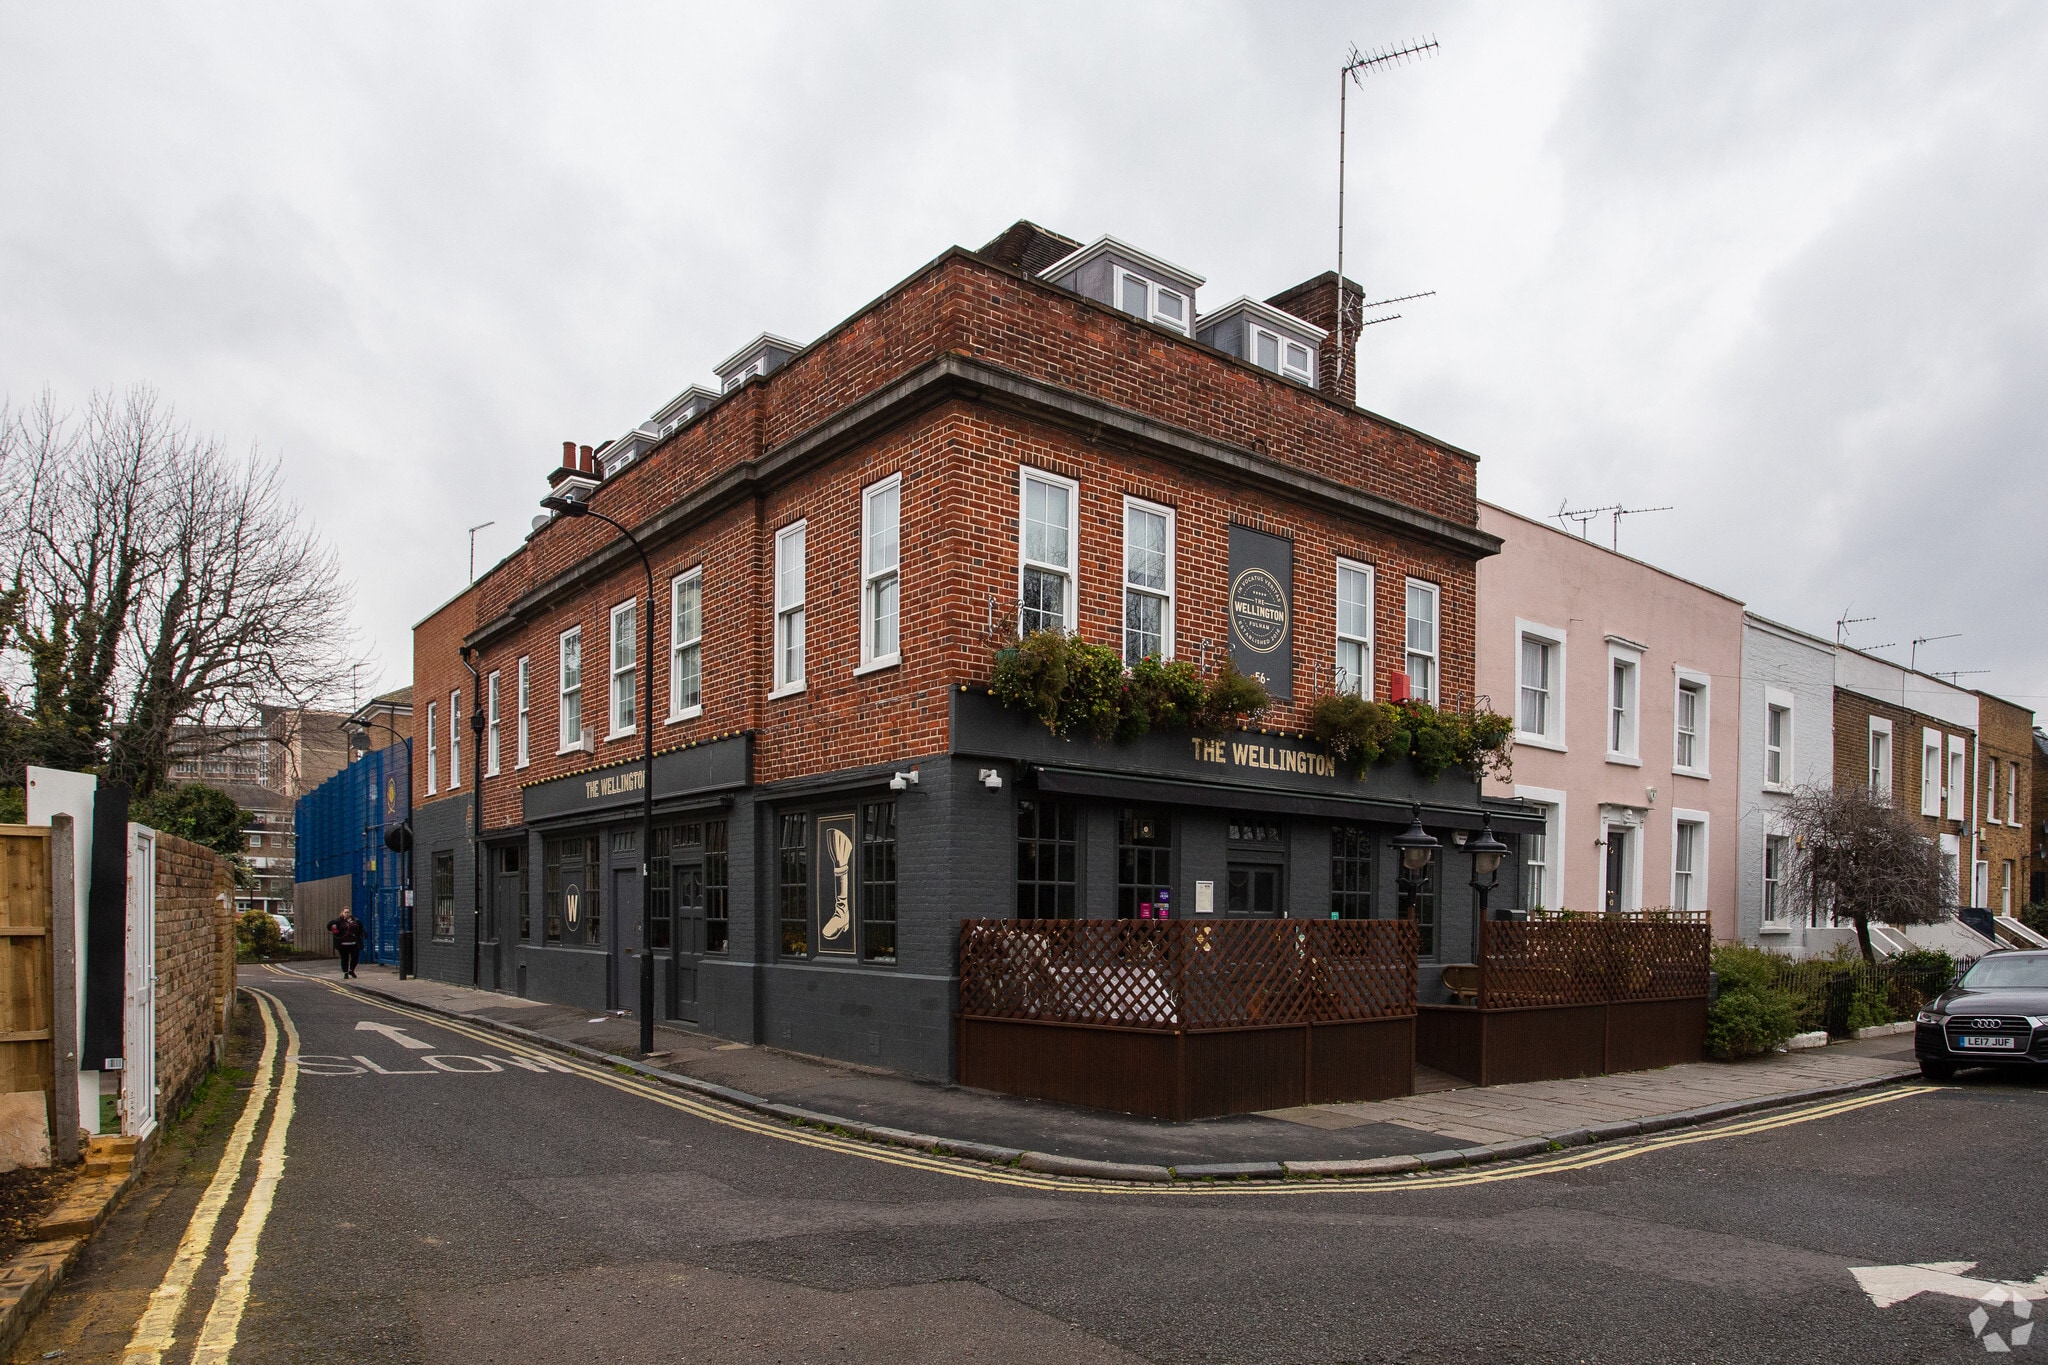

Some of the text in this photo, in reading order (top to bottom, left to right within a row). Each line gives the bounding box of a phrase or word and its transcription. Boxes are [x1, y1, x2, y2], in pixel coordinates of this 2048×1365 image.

[1234, 600, 1284, 622] WELLINGTON
[1254, 598, 1265, 606] THE
[1238, 620, 1270, 645] ESTABLISHED
[1249, 620, 1270, 630] FULHAM
[1191, 737, 1335, 777] THE WELLINGTON
[586, 780, 599, 799] THE
[567, 894, 578, 922] W
[1968, 1037, 2011, 1046] LE17 JUF
[286, 1055, 577, 1075] SLOW
